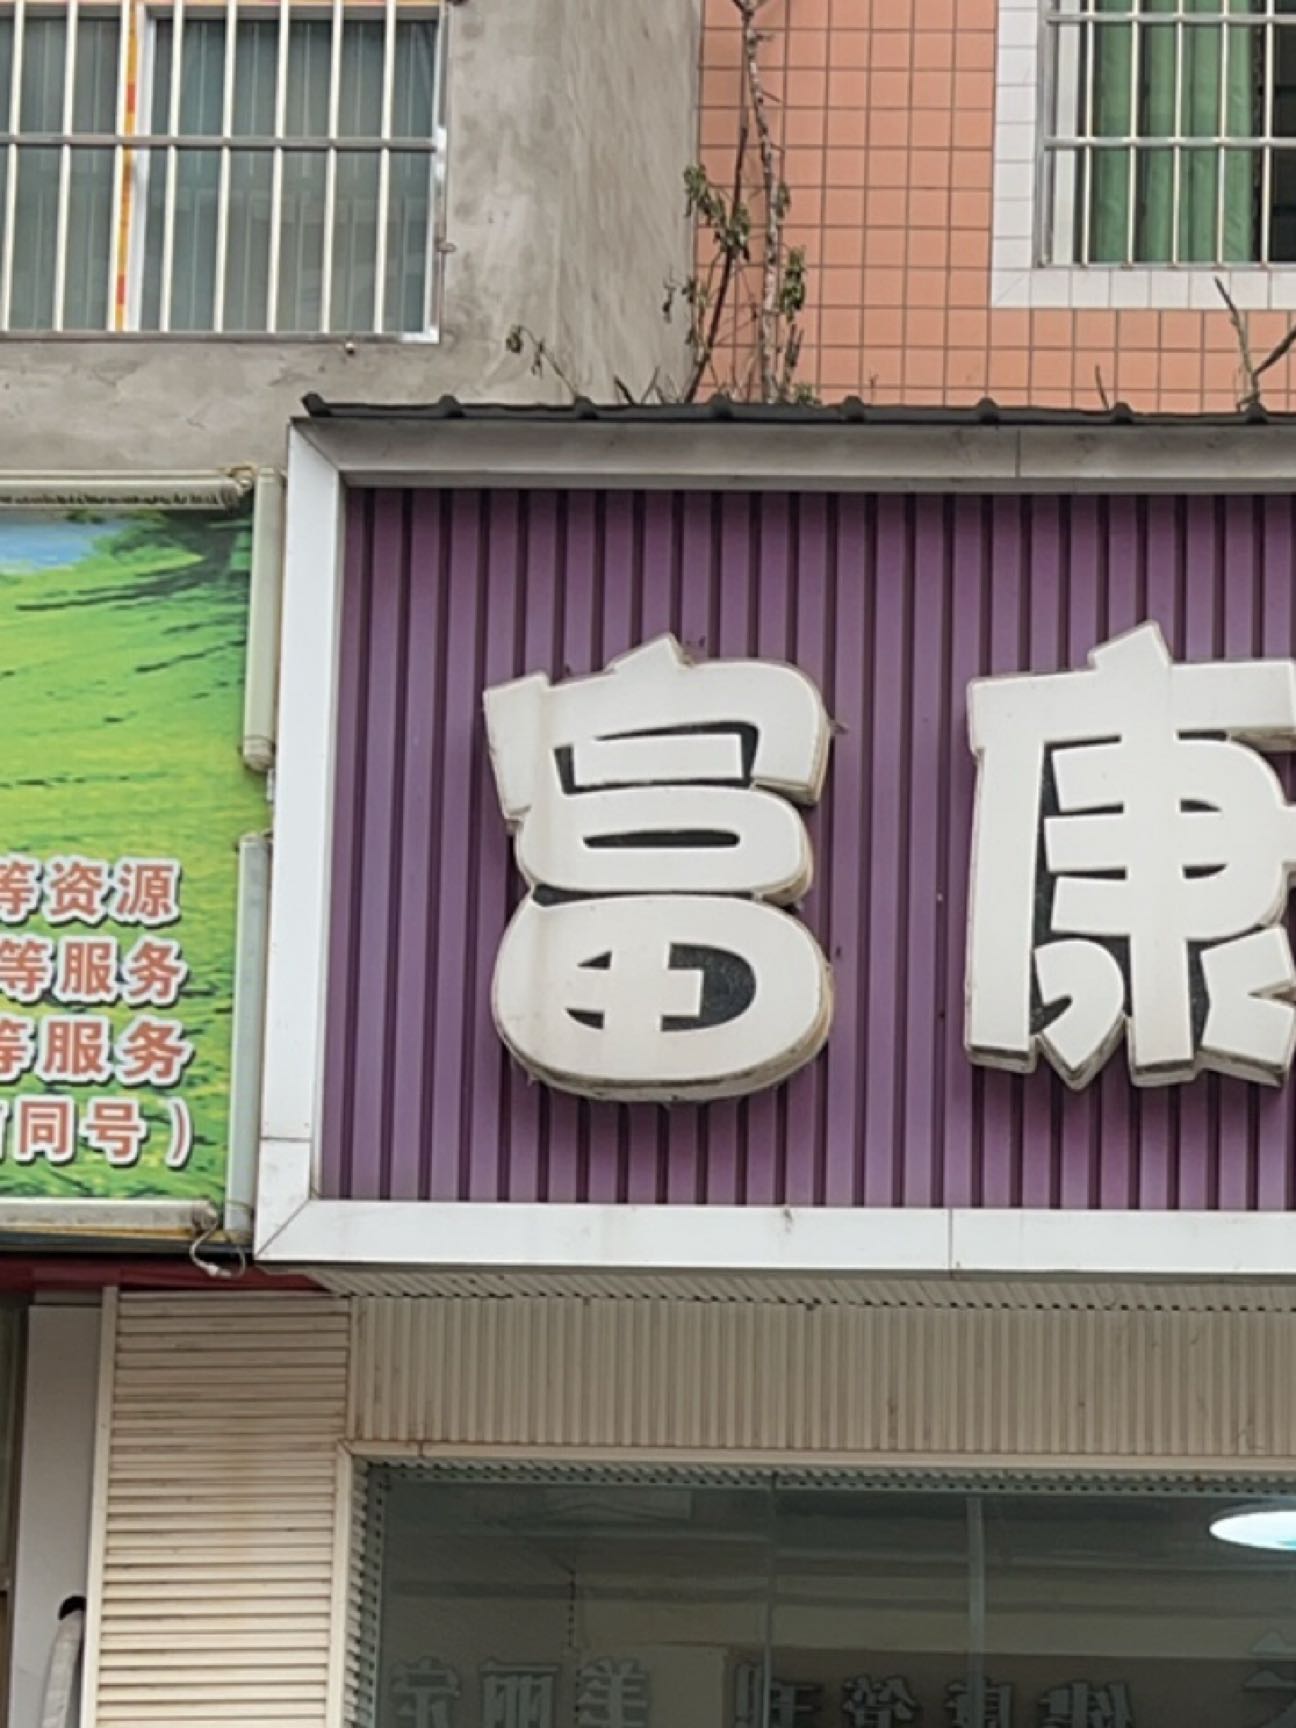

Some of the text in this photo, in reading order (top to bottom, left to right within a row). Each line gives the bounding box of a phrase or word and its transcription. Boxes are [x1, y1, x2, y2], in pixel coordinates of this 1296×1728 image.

[0, 863, 174, 918] 等资源
[0, 940, 181, 998] 等服务
